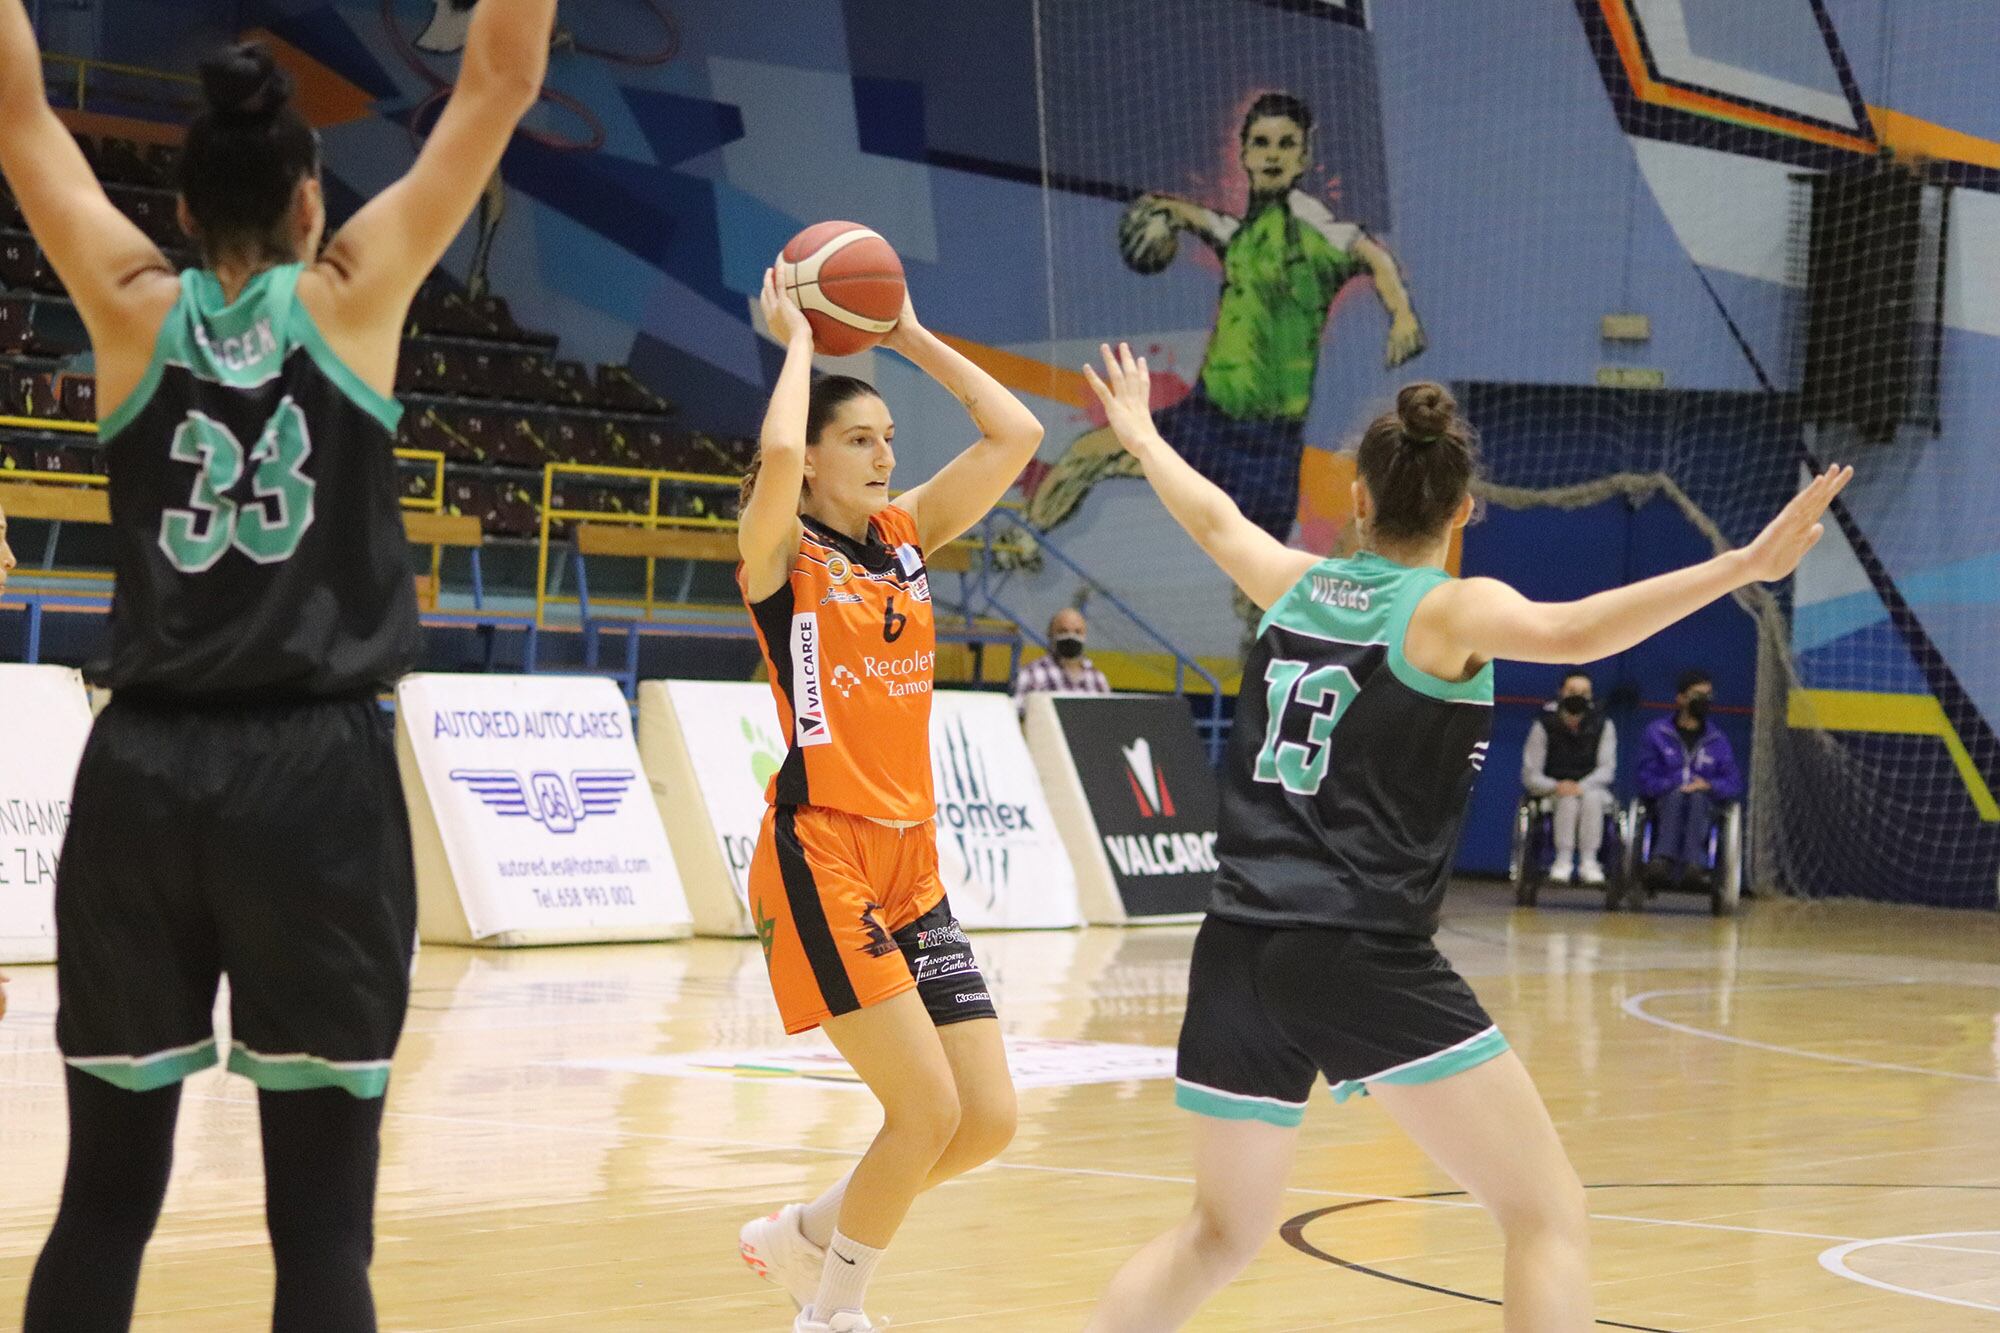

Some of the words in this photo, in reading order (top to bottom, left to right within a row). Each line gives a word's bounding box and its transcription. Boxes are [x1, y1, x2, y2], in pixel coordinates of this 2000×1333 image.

[158, 395, 316, 573] 33
[882, 596, 907, 643] 6
[801, 620, 819, 708] VALCARCE
[434, 710, 521, 739] AUTORED
[524, 710, 624, 739] AUTOCARES
[1252, 658, 1361, 796] 13
[935, 803, 1035, 831] romex
